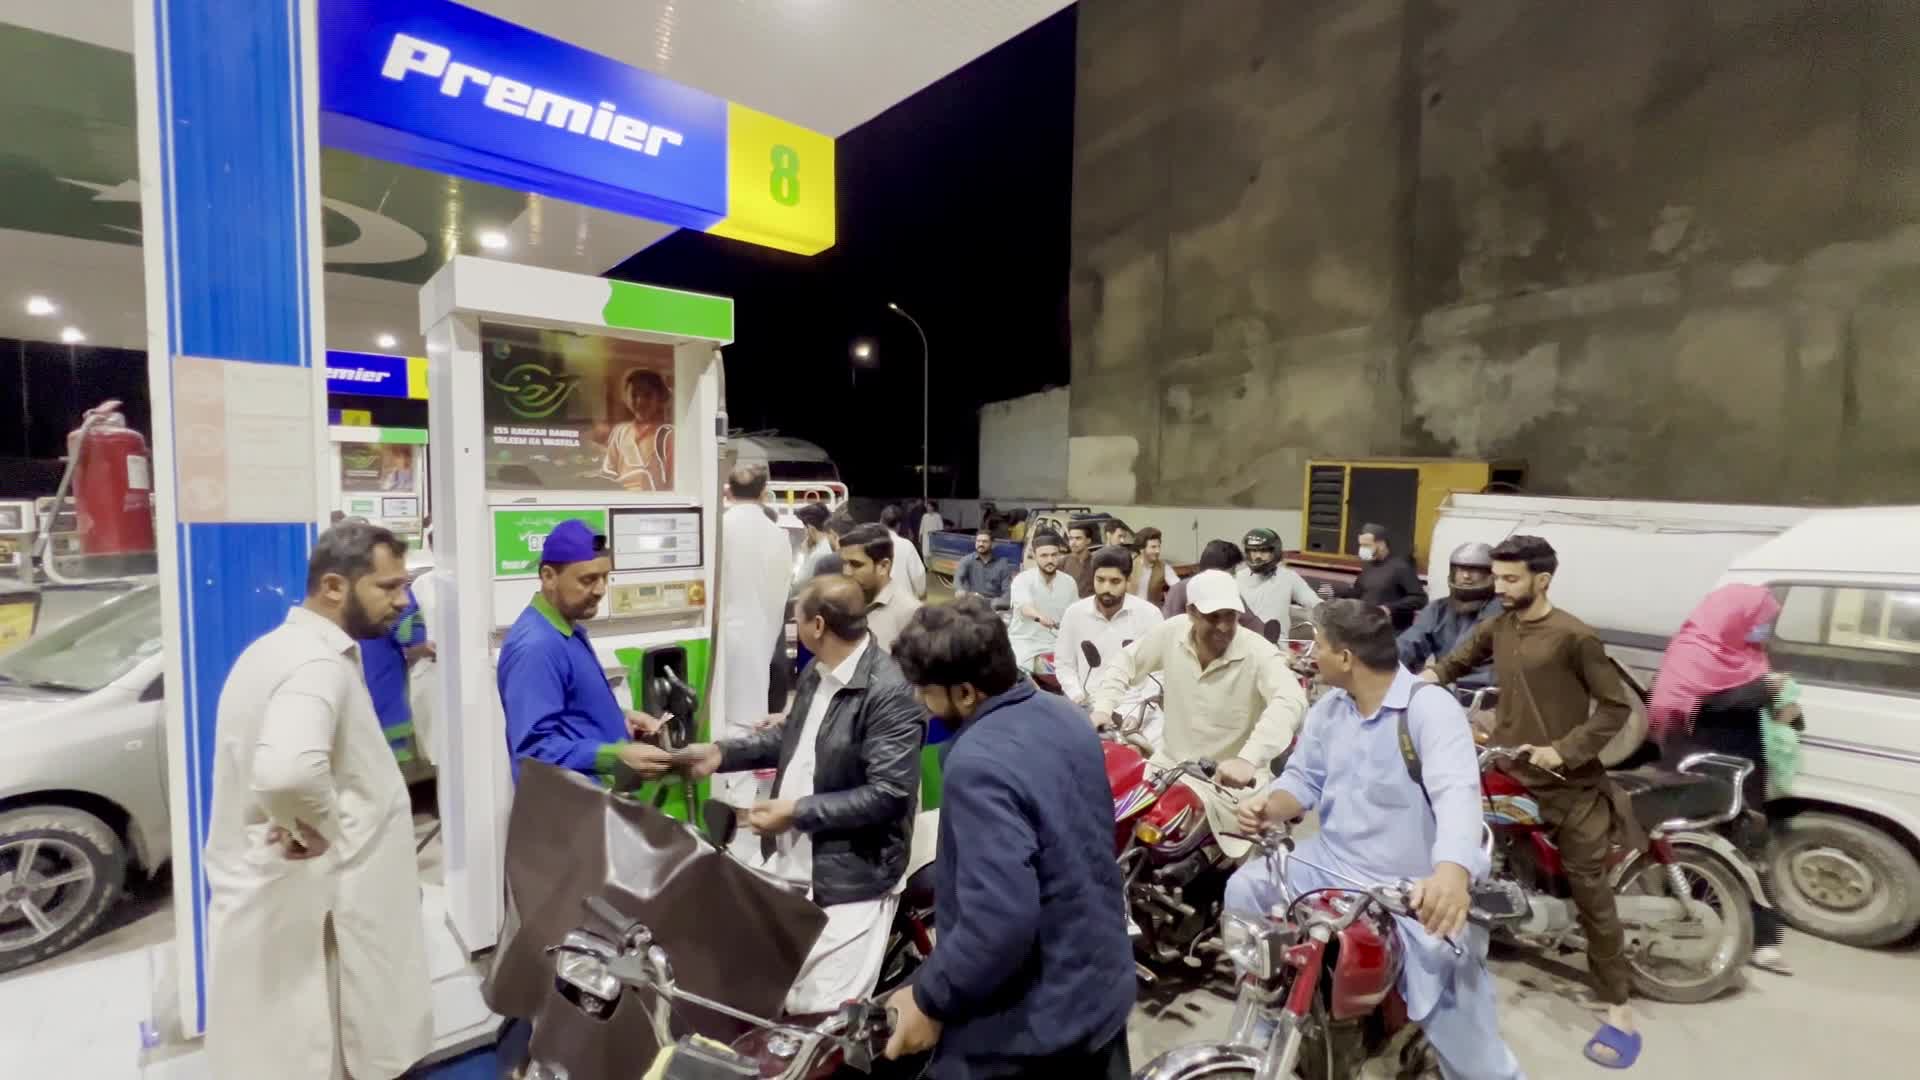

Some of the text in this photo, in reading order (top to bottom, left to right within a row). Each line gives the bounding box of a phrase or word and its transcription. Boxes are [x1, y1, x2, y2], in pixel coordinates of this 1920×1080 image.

[381, 33, 683, 157] Premier
[769, 144, 800, 207] 8
[325, 367, 391, 383] emier
